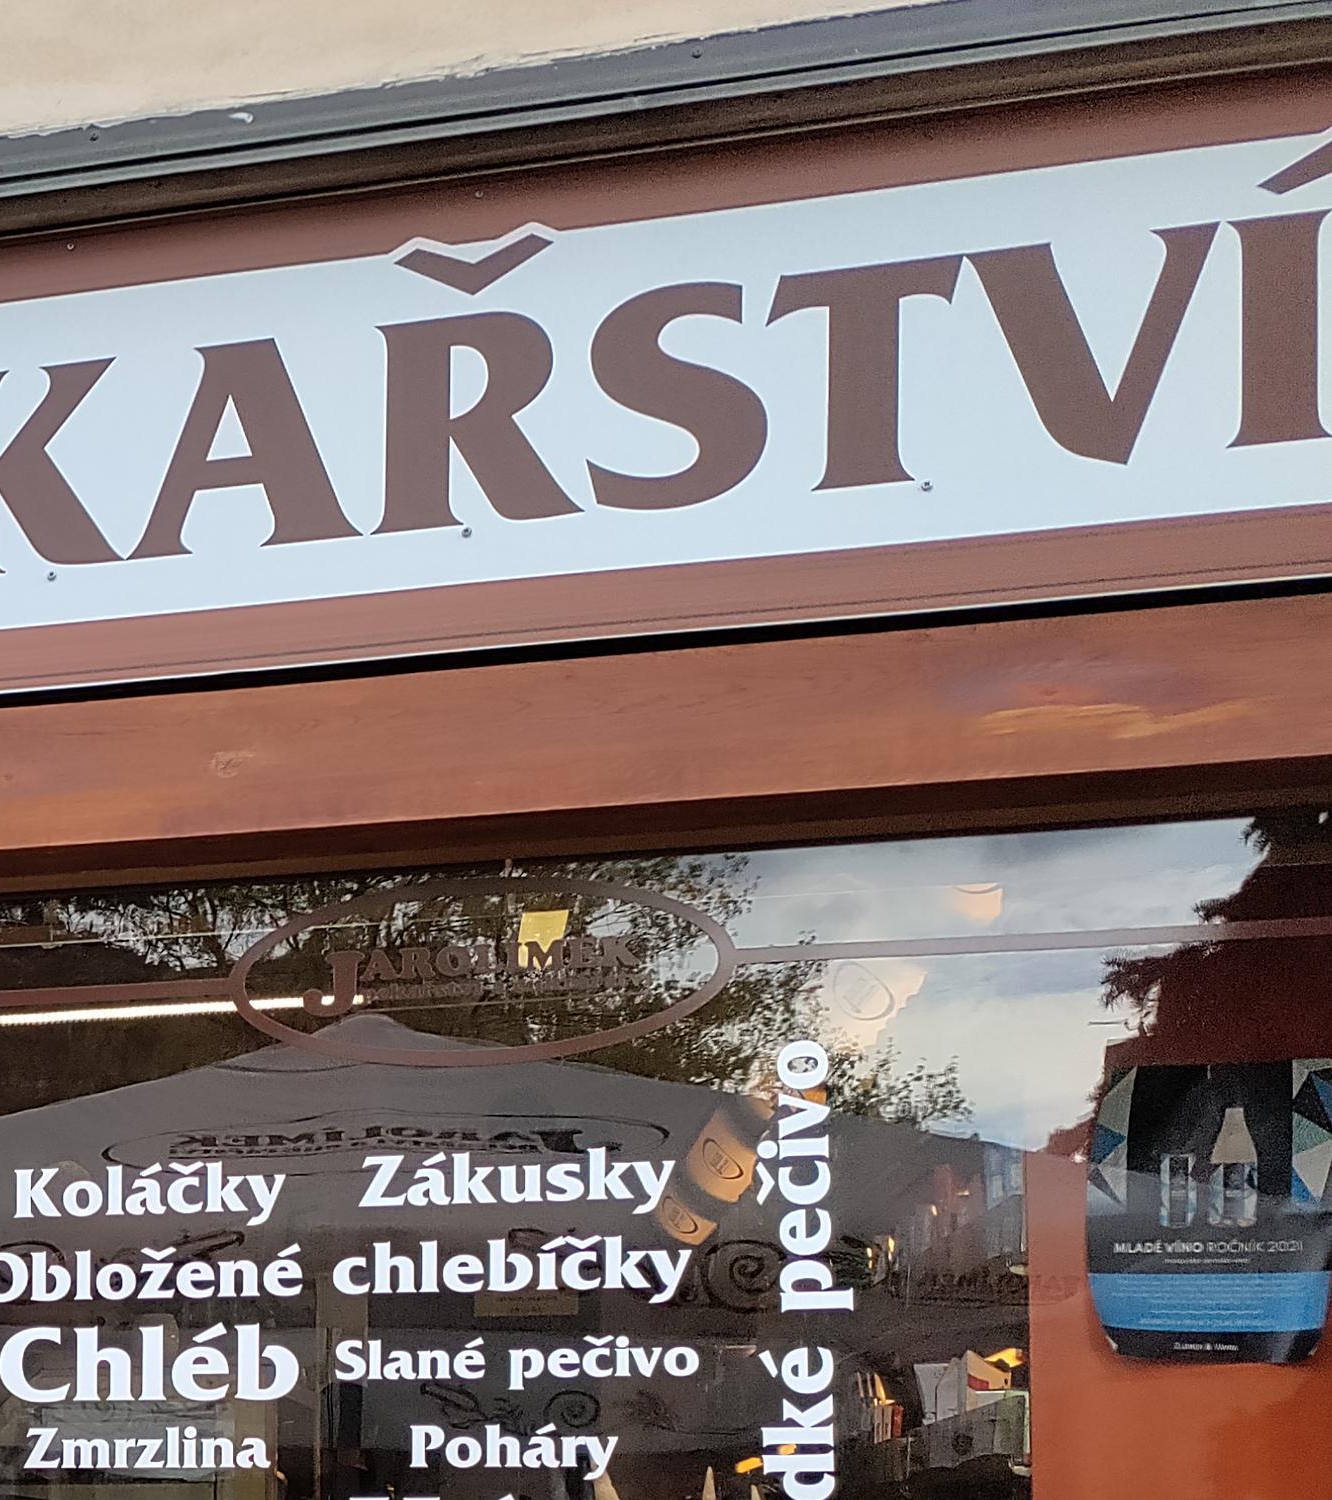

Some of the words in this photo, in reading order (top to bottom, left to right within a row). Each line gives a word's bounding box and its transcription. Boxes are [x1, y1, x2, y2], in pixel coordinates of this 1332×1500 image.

[14, 1161, 285, 1226] Koláčky
[358, 1148, 676, 1214] Zákusky
[757, 1040, 854, 1314] pečivo
[333, 1235, 692, 1304] chlebíčky
[335, 1337, 486, 1381] Slané
[509, 1335, 700, 1390] pečivo
[24, 1426, 271, 1469] Zmrzlina
[410, 1423, 618, 1481] Poháry
